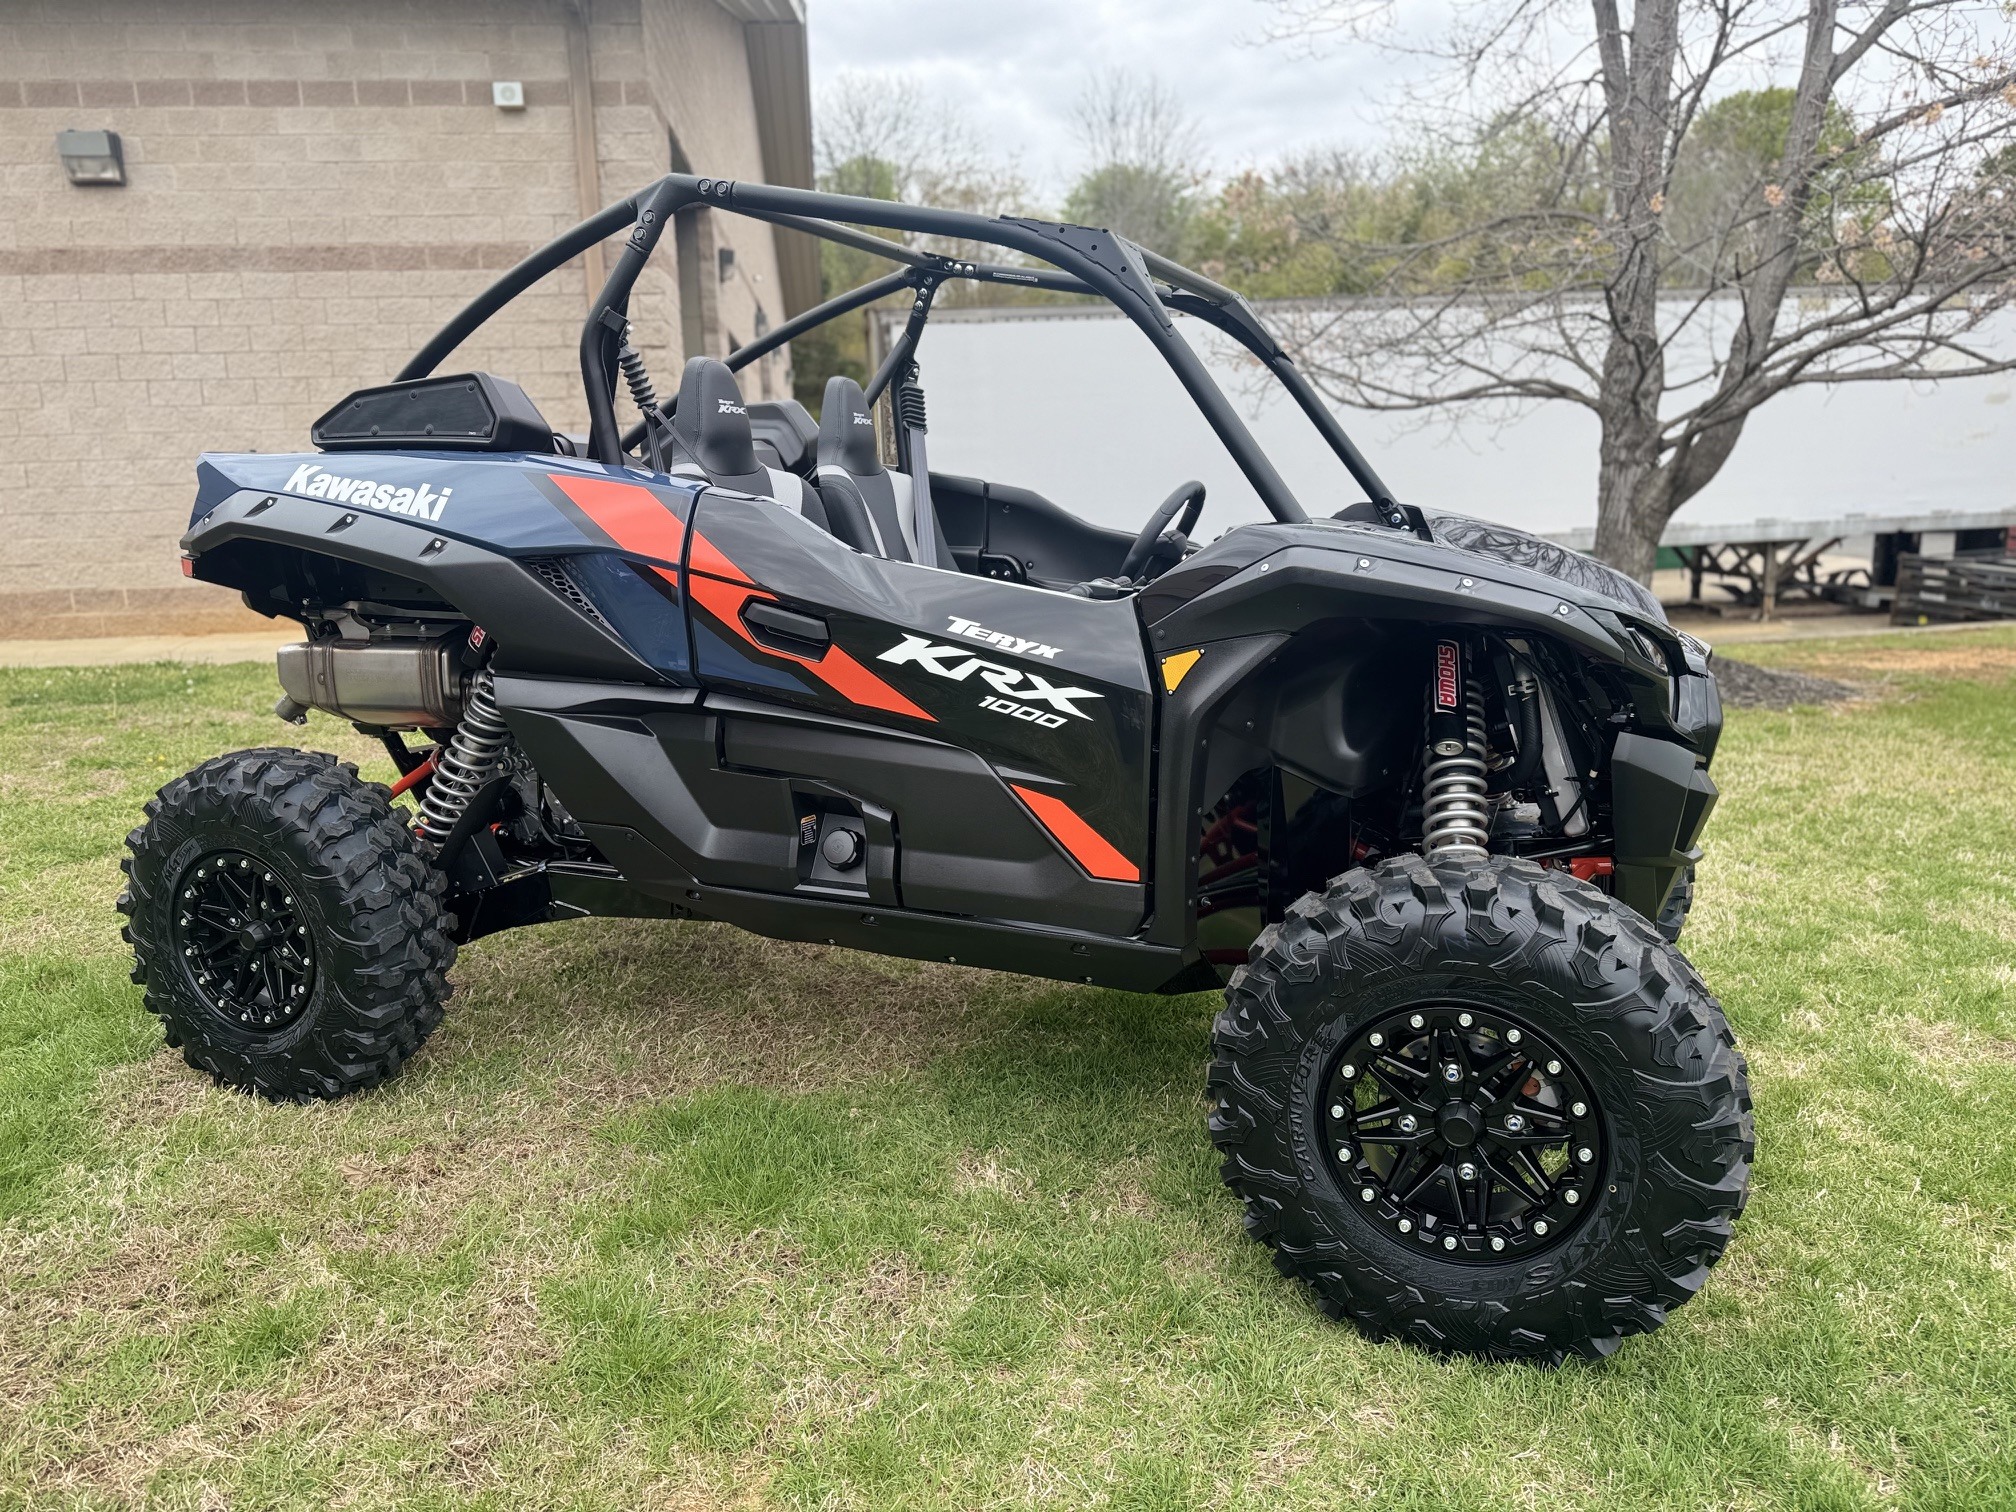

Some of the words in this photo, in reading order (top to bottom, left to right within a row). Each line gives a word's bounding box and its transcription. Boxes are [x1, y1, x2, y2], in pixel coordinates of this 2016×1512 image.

[718, 405, 746, 414] KRX
[853, 417, 873, 425] KRX
[282, 463, 453, 522] Kawasaki
[947, 616, 1063, 659] TERYX
[876, 633, 1105, 721] KRX
[1438, 645, 1456, 707] SHOWA
[978, 696, 1068, 728] 1000
[1290, 1022, 1326, 1181] CARNIVORE
